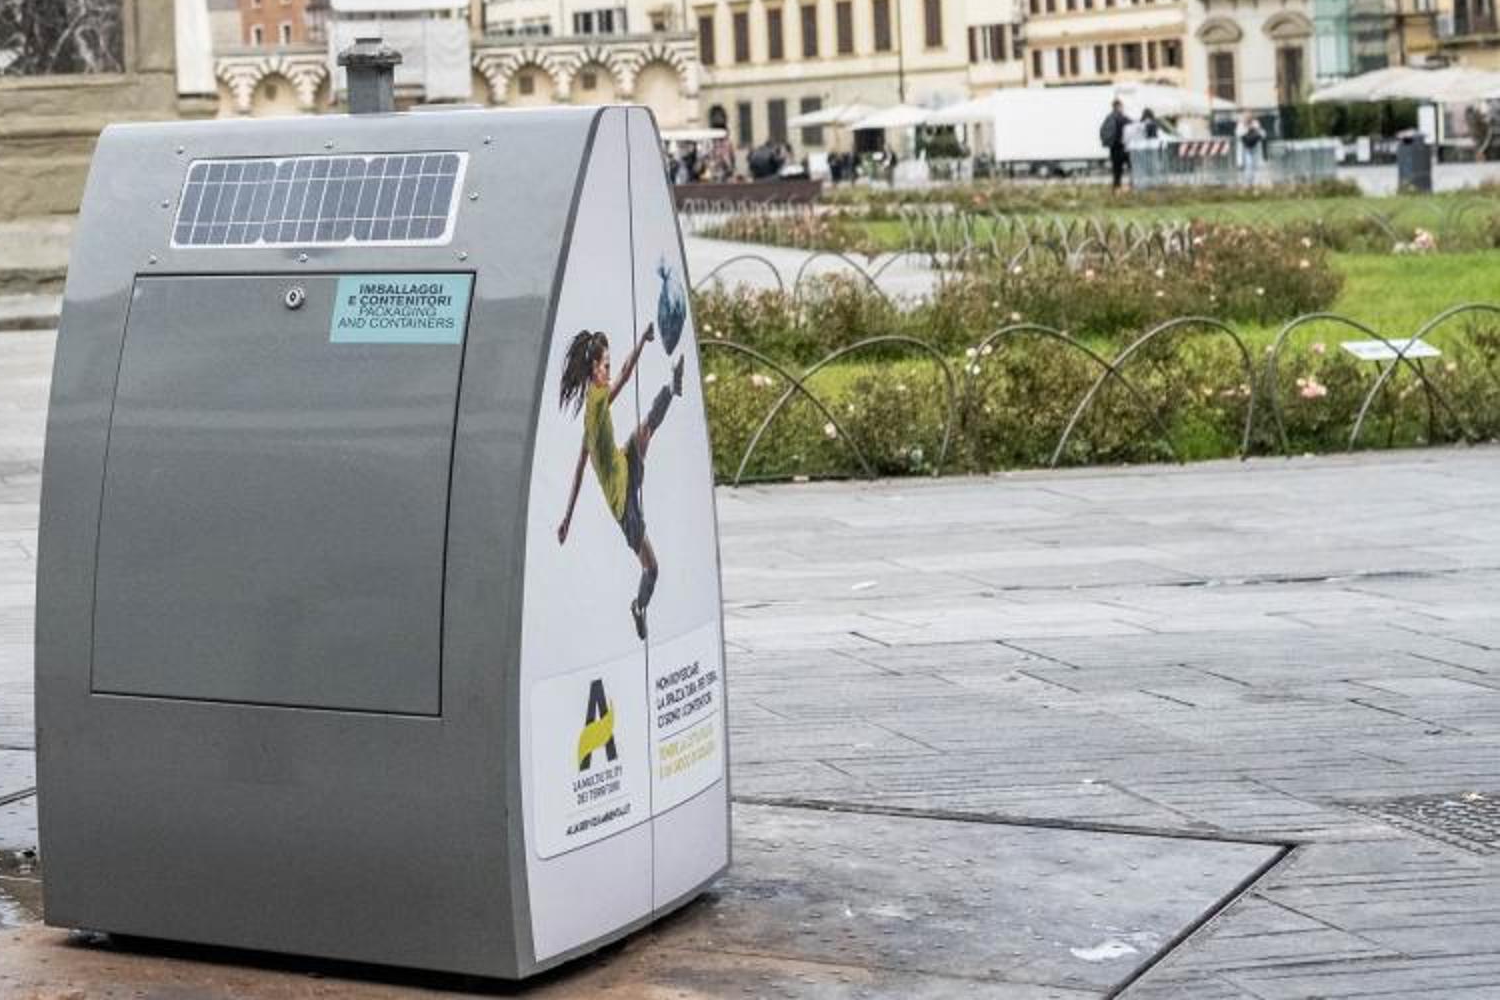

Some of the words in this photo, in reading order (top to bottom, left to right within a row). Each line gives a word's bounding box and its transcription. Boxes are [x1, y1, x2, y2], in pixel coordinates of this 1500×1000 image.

[359, 283, 443, 295] IMBALLAGGI
[347, 295, 357, 306] E
[359, 295, 452, 306] CONTENITORI
[359, 306, 437, 317] PACKAGING
[337, 317, 366, 328] AND
[369, 317, 455, 328] CONTAINERS
